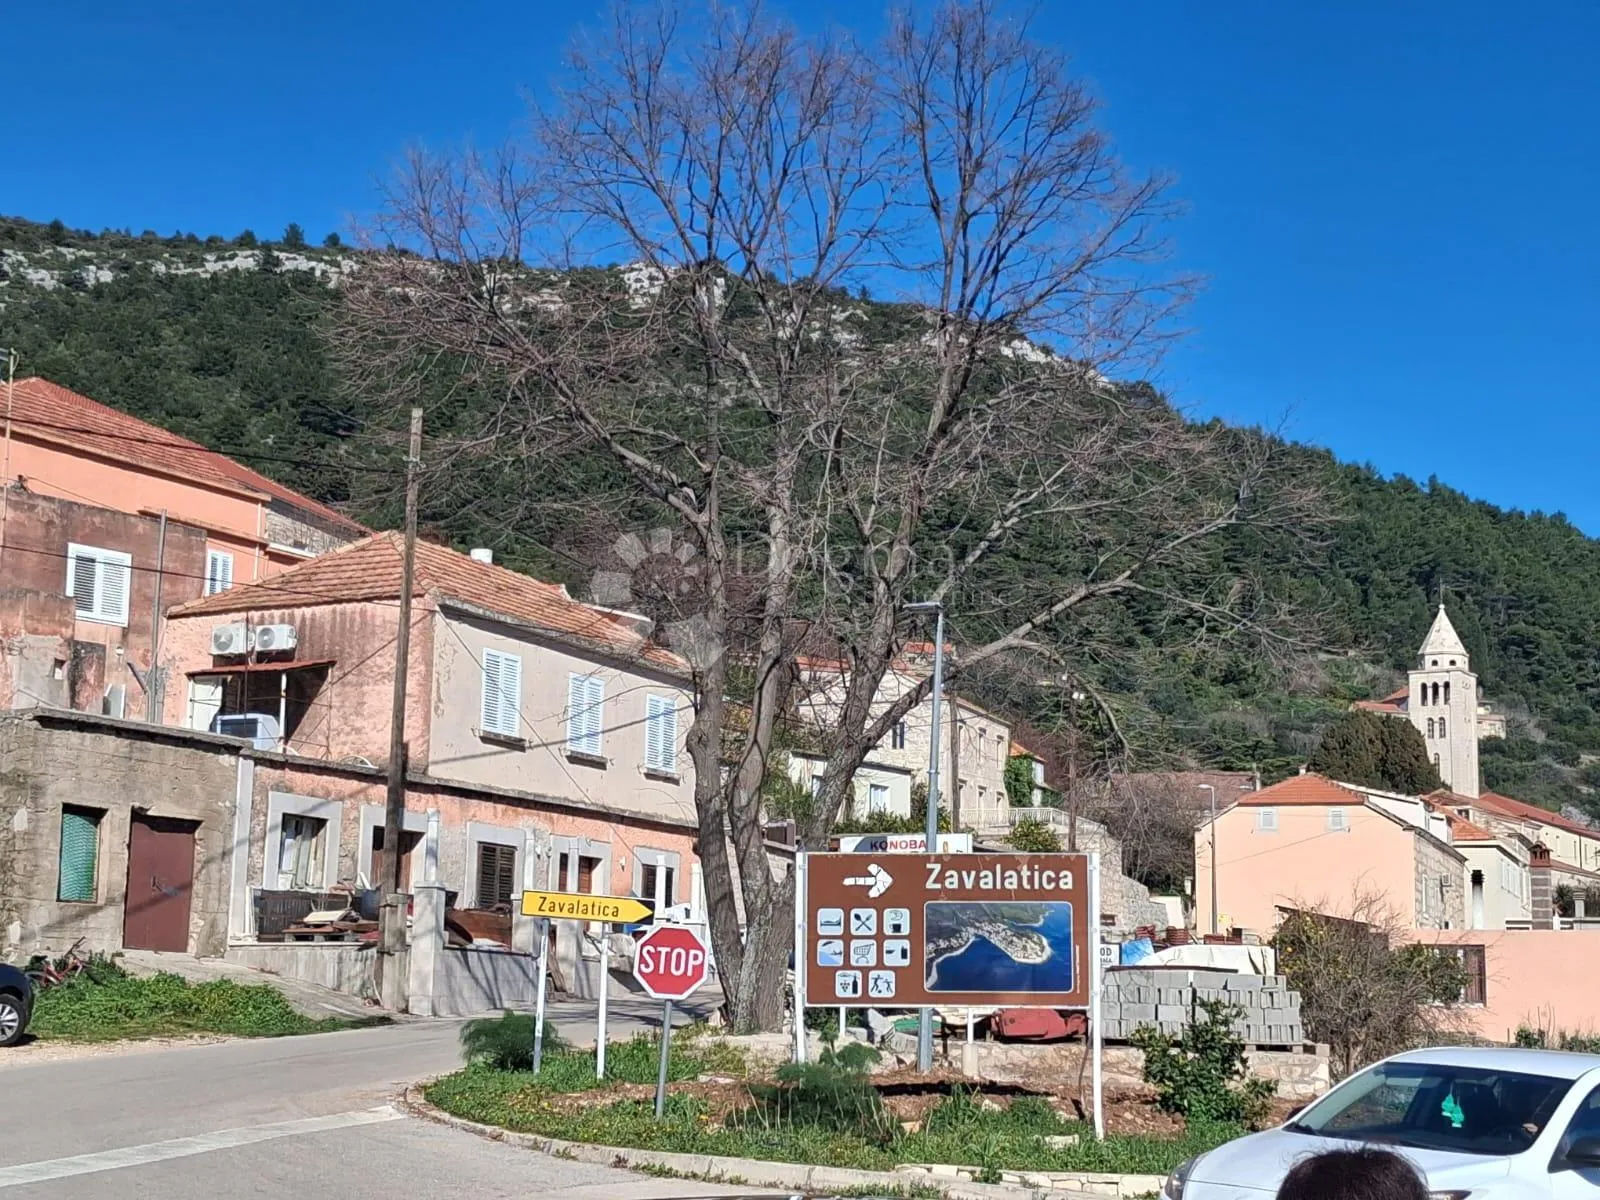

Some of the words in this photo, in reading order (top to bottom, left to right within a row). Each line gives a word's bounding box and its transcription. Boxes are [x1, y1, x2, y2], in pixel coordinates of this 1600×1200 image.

[870, 839, 927, 850] KONOBA
[925, 863, 1073, 890] Zavalatica
[538, 896, 620, 917] Zavalatica
[640, 945, 703, 977] STOP
